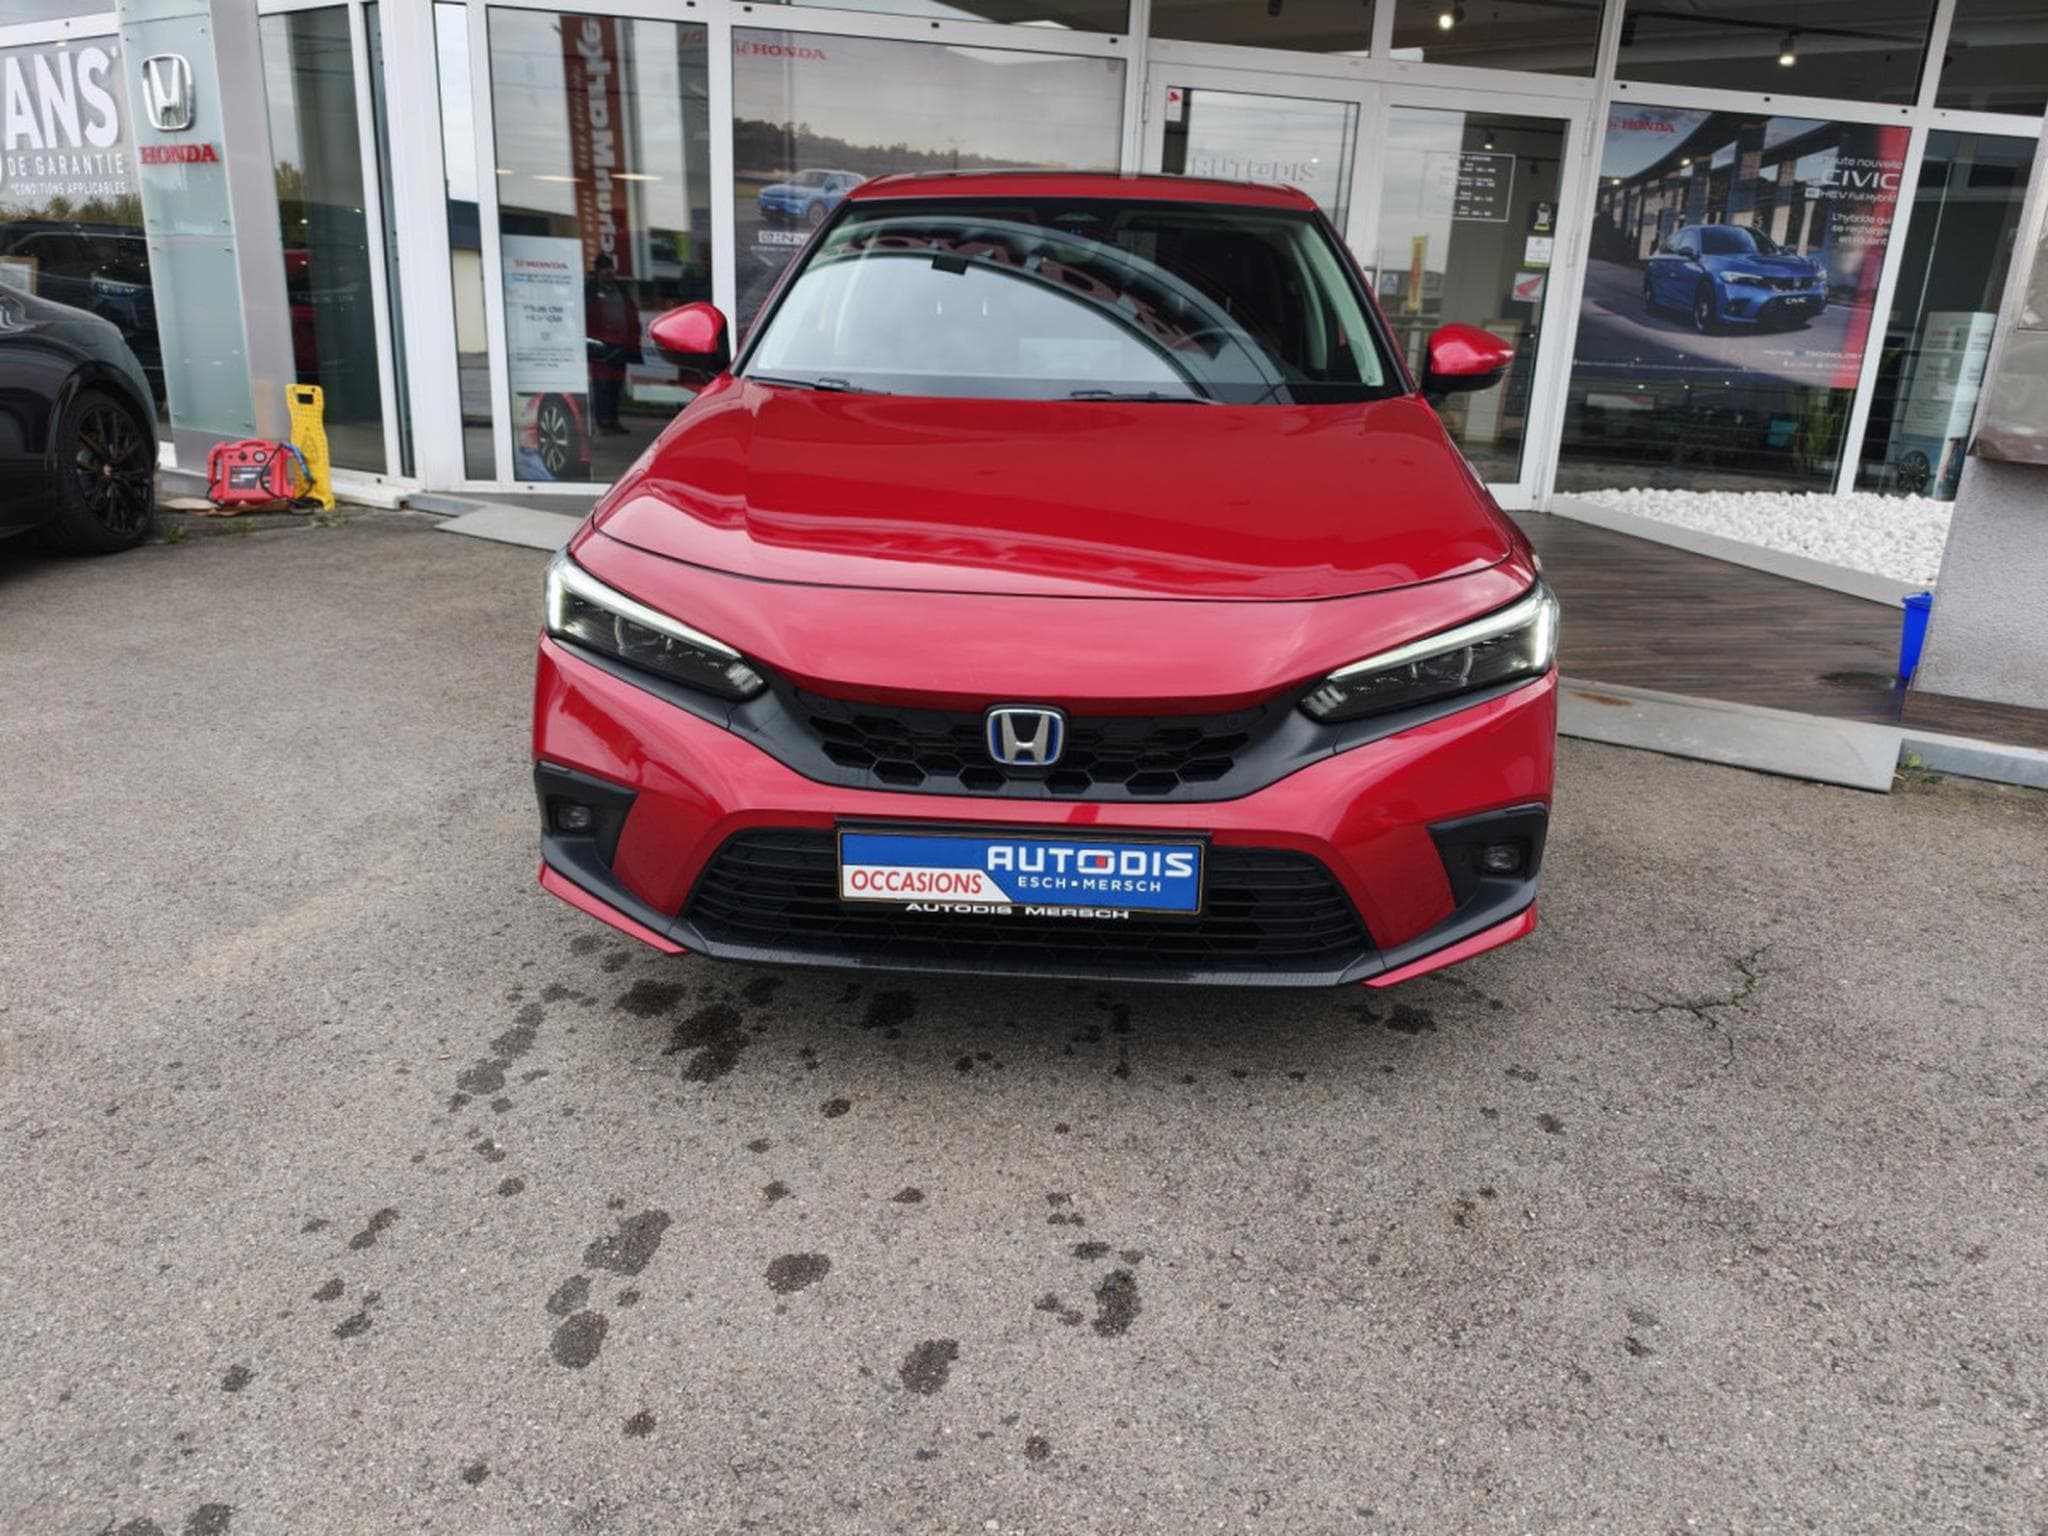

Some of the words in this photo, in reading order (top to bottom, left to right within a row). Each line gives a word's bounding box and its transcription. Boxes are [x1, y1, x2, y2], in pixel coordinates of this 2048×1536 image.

[752, 43, 827, 61] HONDA
[1622, 119, 1675, 131] HONDA
[8, 156, 27, 176] DE
[35, 153, 125, 176] GARANTIE
[138, 143, 220, 165] HONDA
[1821, 168, 1901, 190] CIVIC
[988, 845, 1194, 878] AUTODIS
[851, 869, 982, 894] OCCASIONS
[1018, 876, 1066, 889] ESCH
[1083, 878, 1161, 892] MERSCH
[905, 902, 1013, 915] AUTODIS
[1025, 906, 1129, 919] MERSCH
